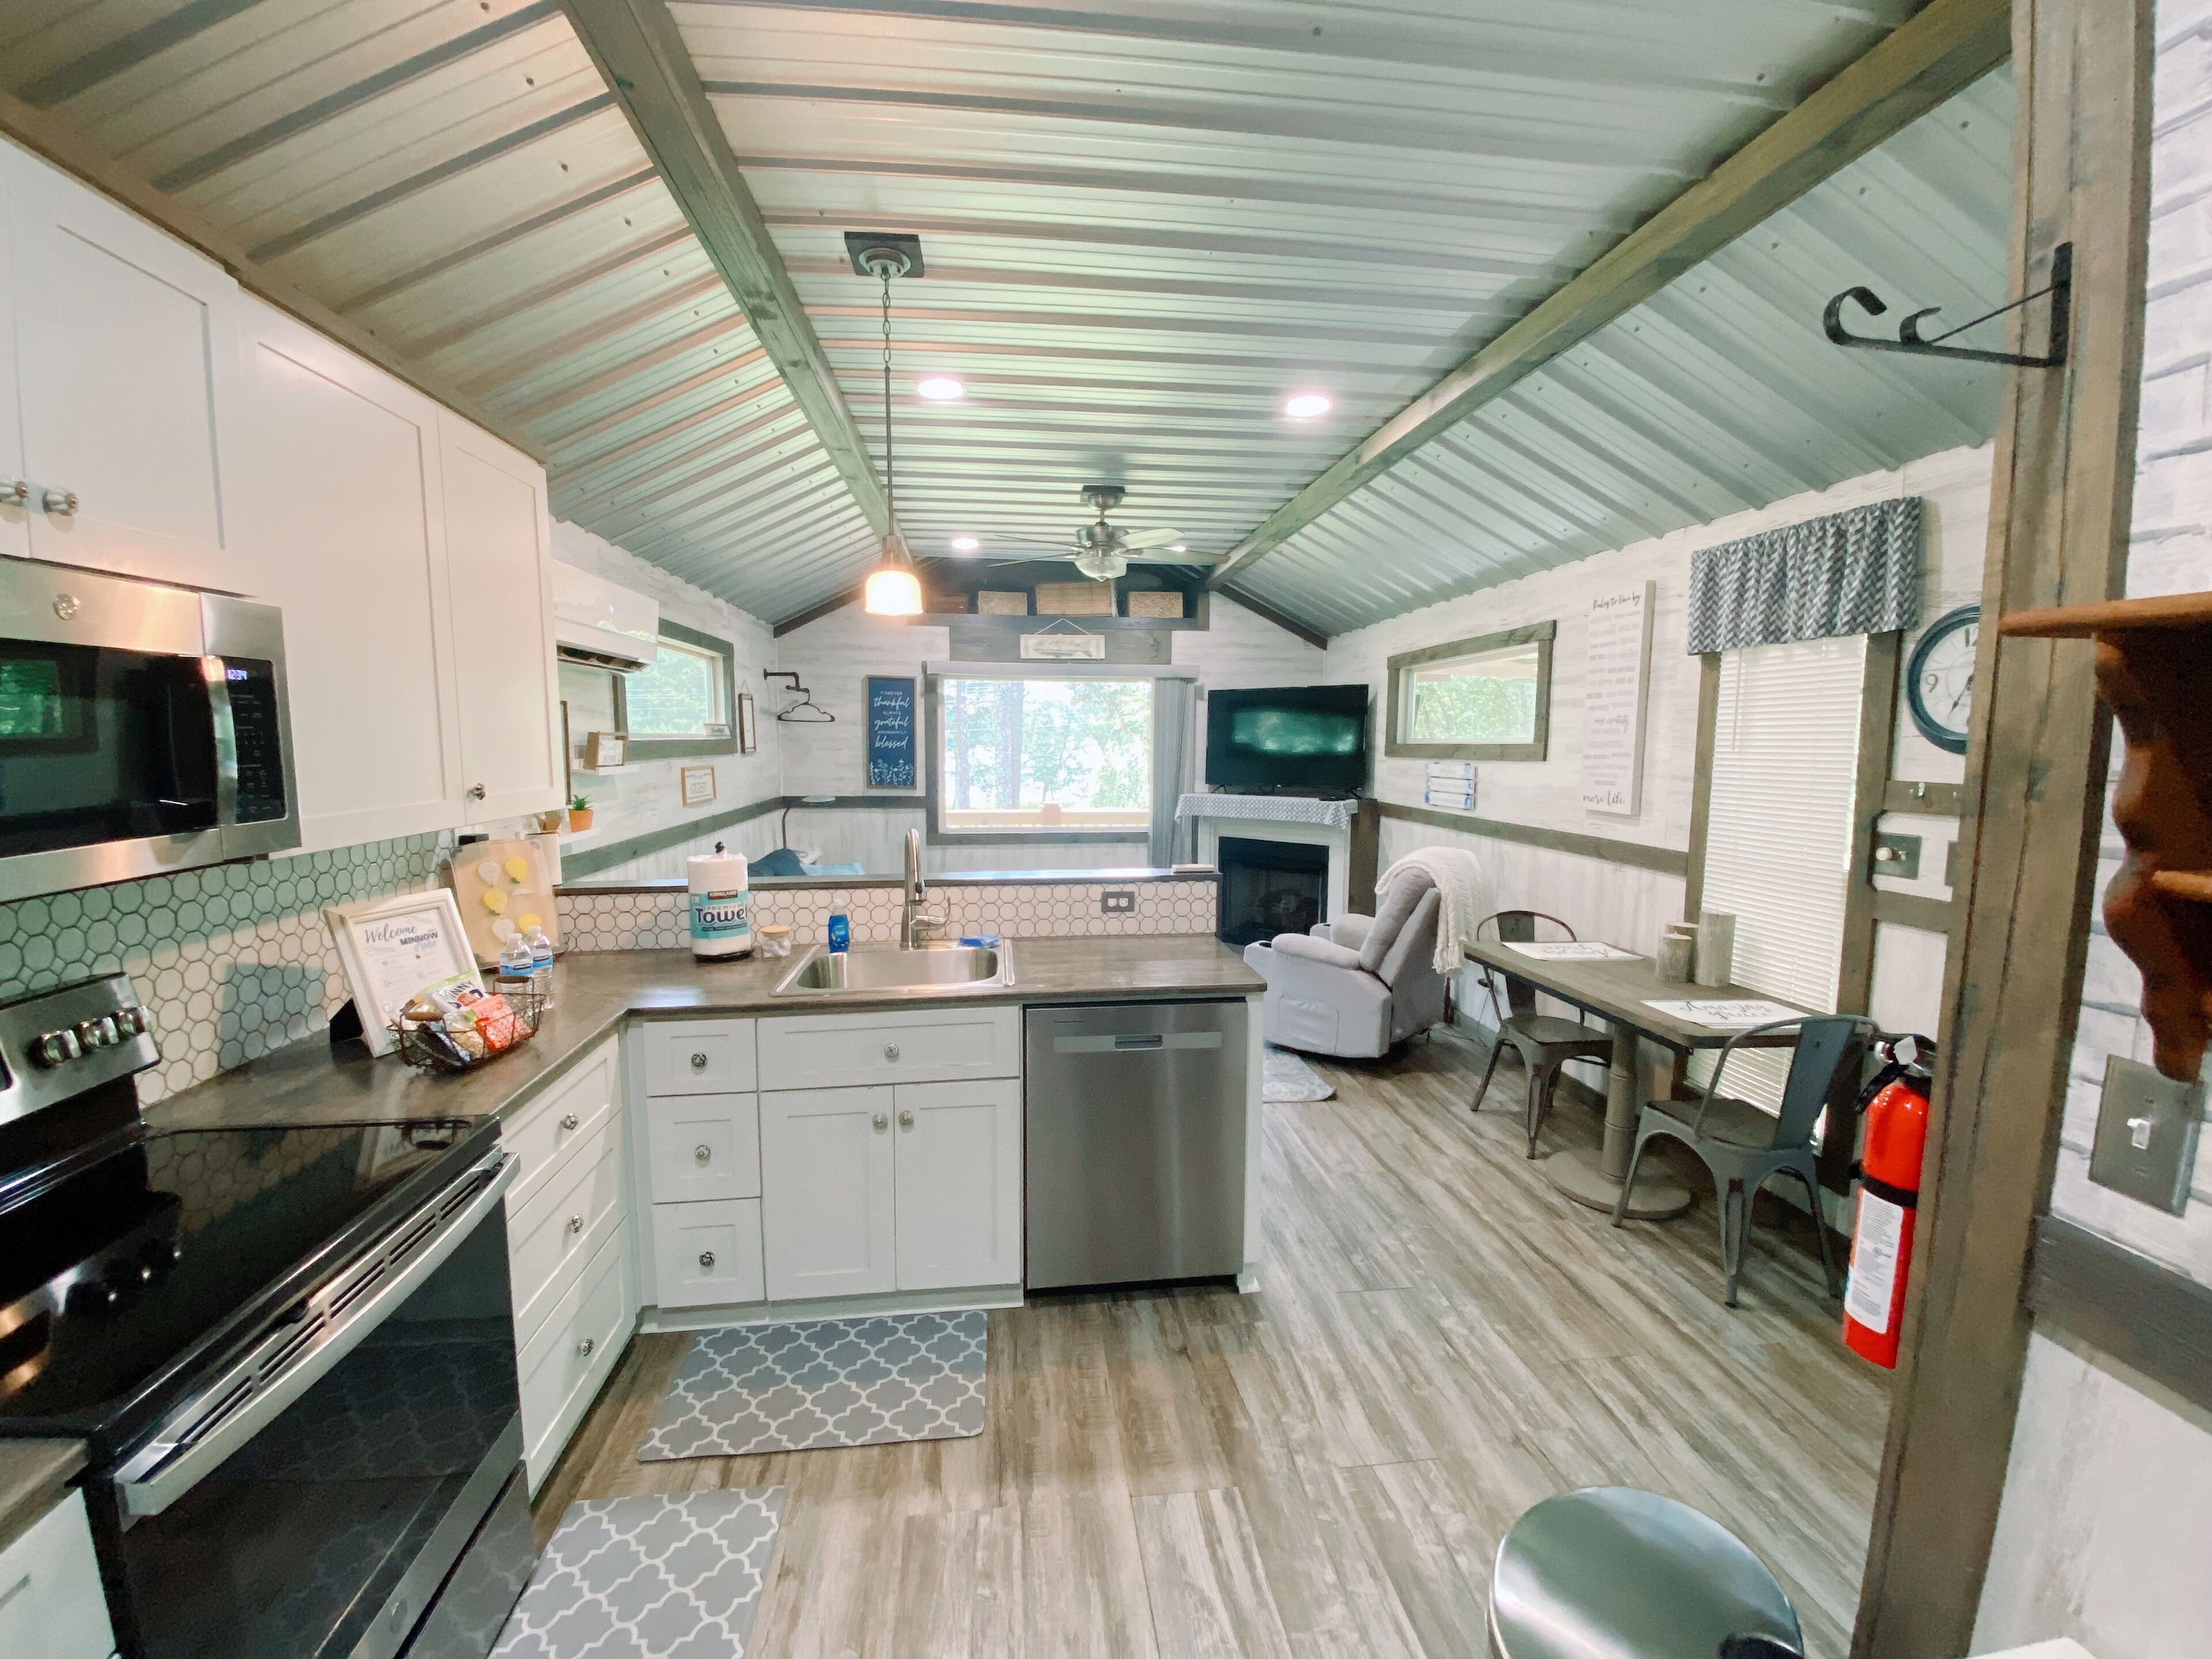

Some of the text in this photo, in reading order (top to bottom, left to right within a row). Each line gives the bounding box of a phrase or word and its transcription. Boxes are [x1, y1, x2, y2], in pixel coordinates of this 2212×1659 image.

[1633, 592, 1641, 606] by
[1925, 673, 1939, 693] 9
[873, 696, 910, 710] thankful
[874, 715, 910, 730] grateful
[875, 734, 909, 750] blessed
[365, 923, 418, 944] Welcome
[400, 931, 438, 945] MINNOW
